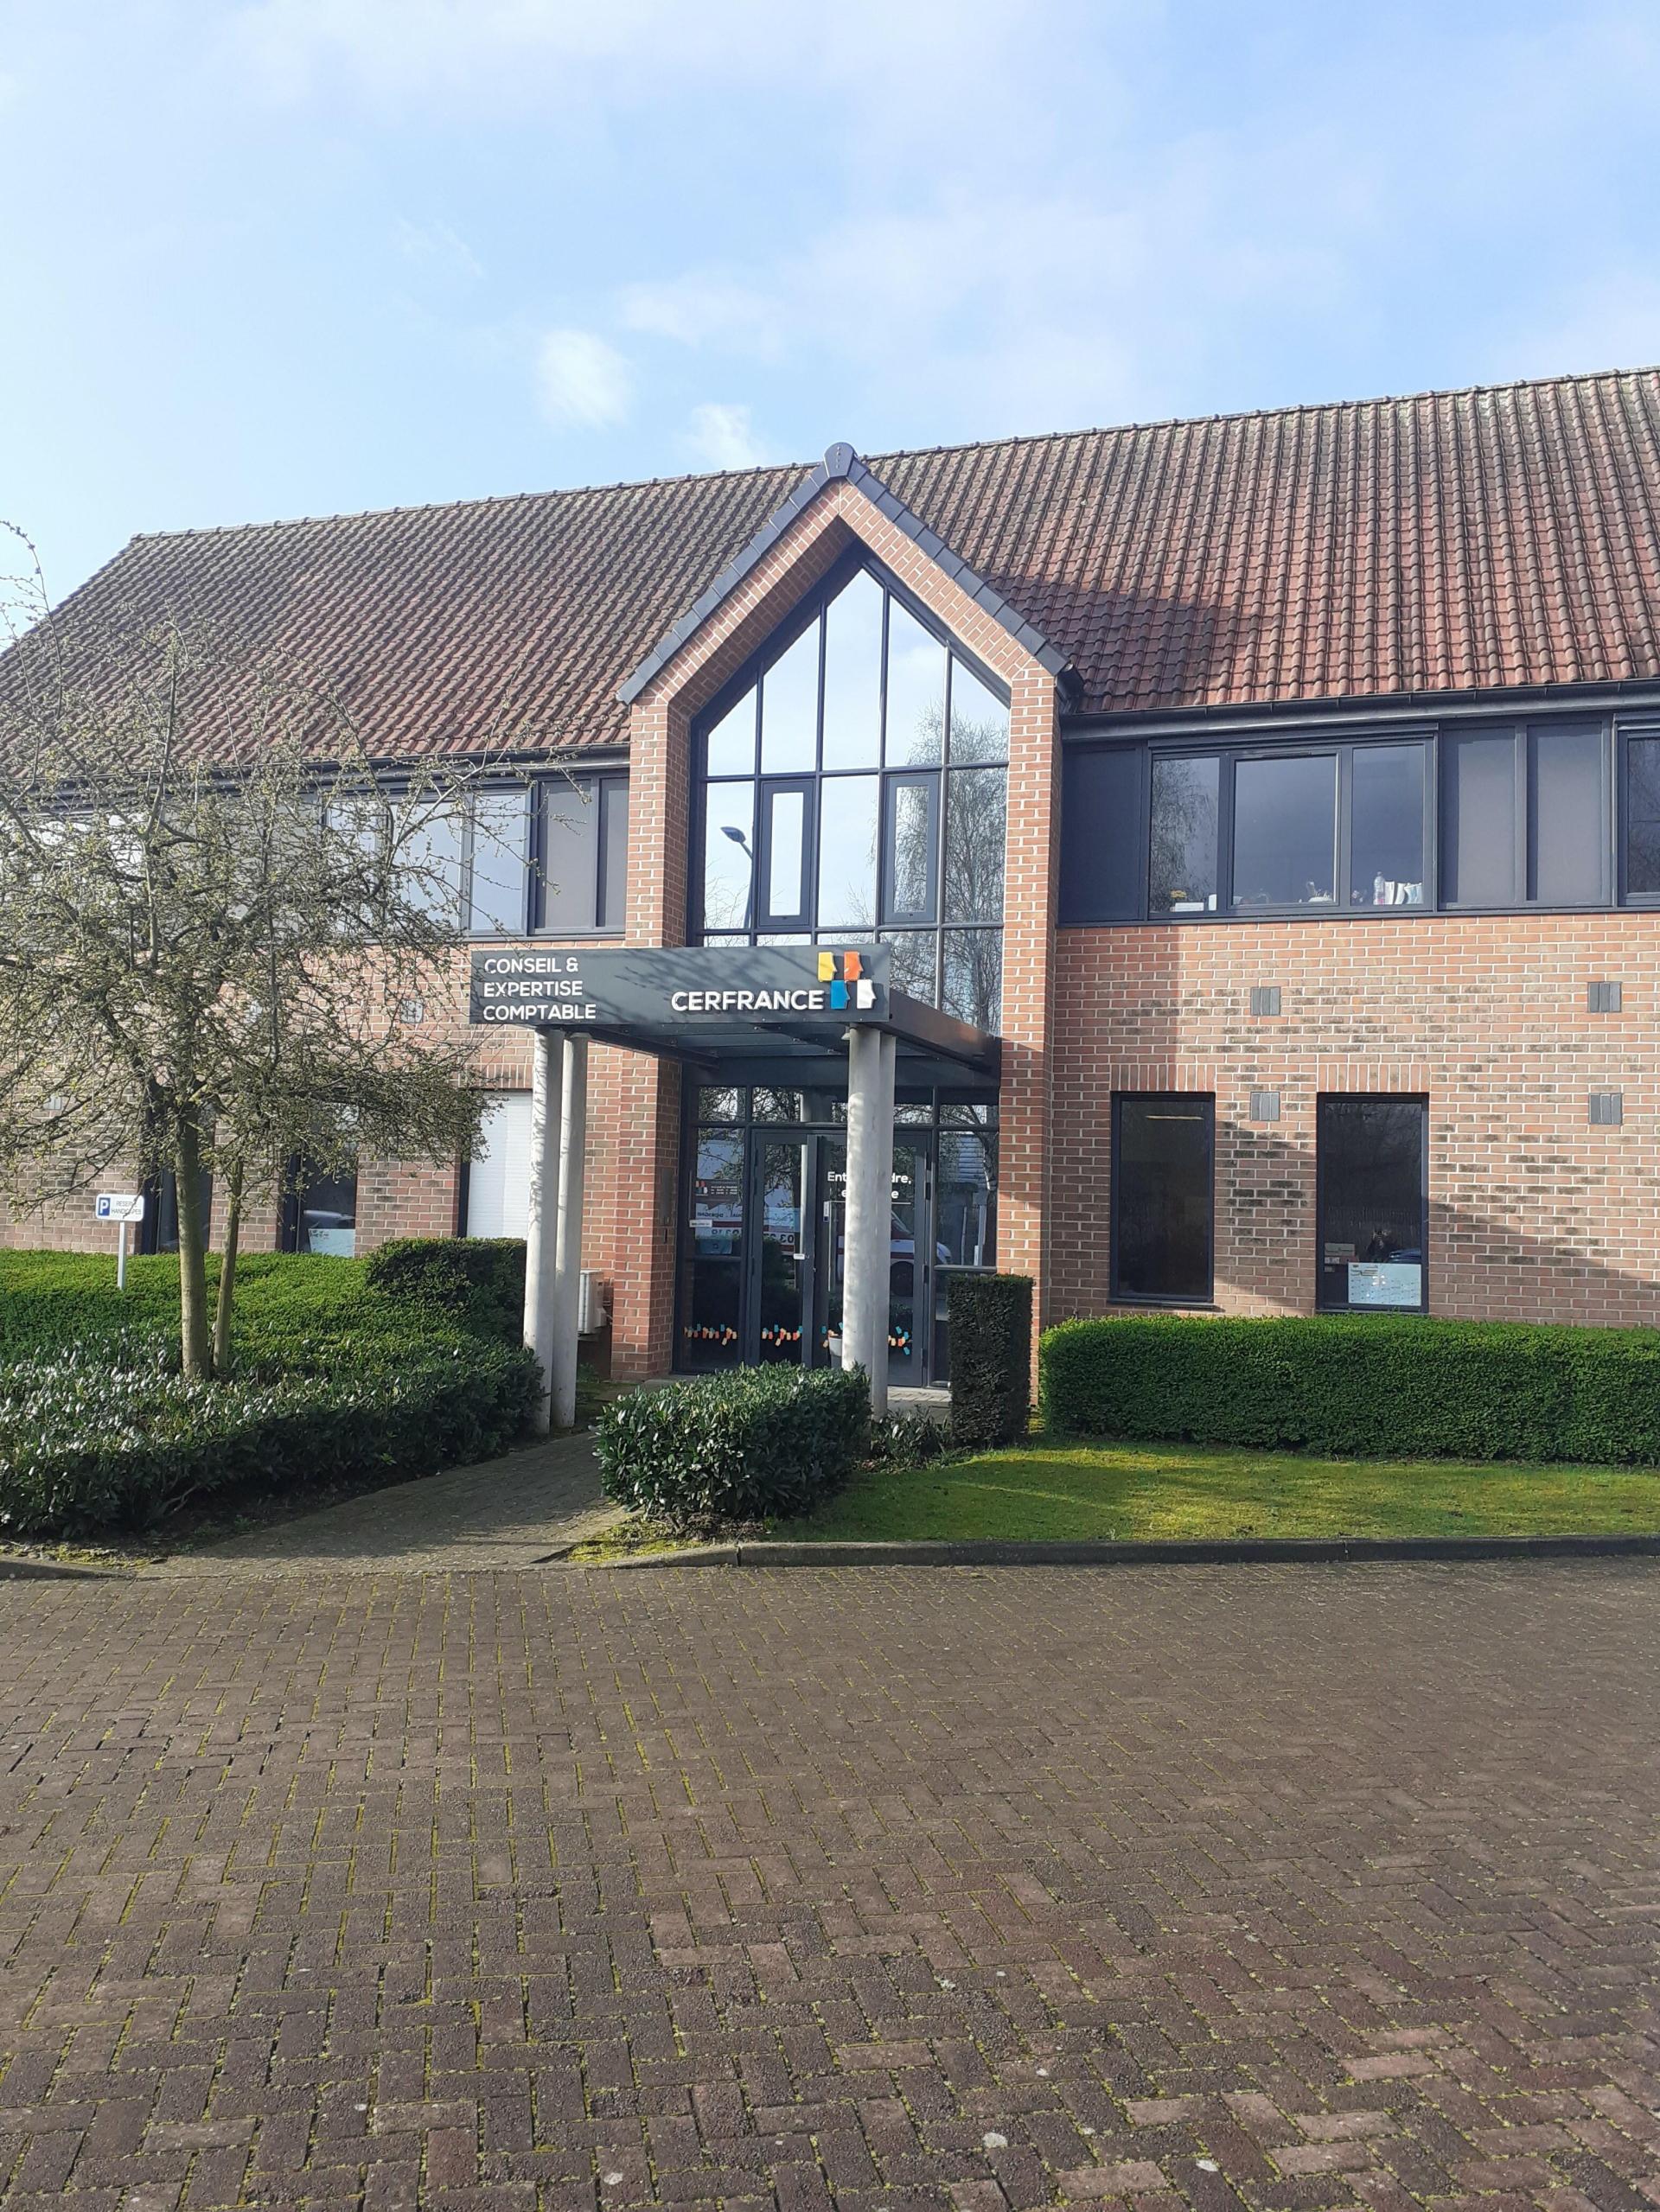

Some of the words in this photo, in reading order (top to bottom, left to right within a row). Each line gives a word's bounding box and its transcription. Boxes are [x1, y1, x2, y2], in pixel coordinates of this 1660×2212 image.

[484, 957, 562, 974] CONSEIL
[566, 956, 578, 972] &
[483, 980, 584, 998] EXPERTISE
[671, 990, 824, 1011] CERFRANCE
[482, 1004, 597, 1021] COMPTABLE
